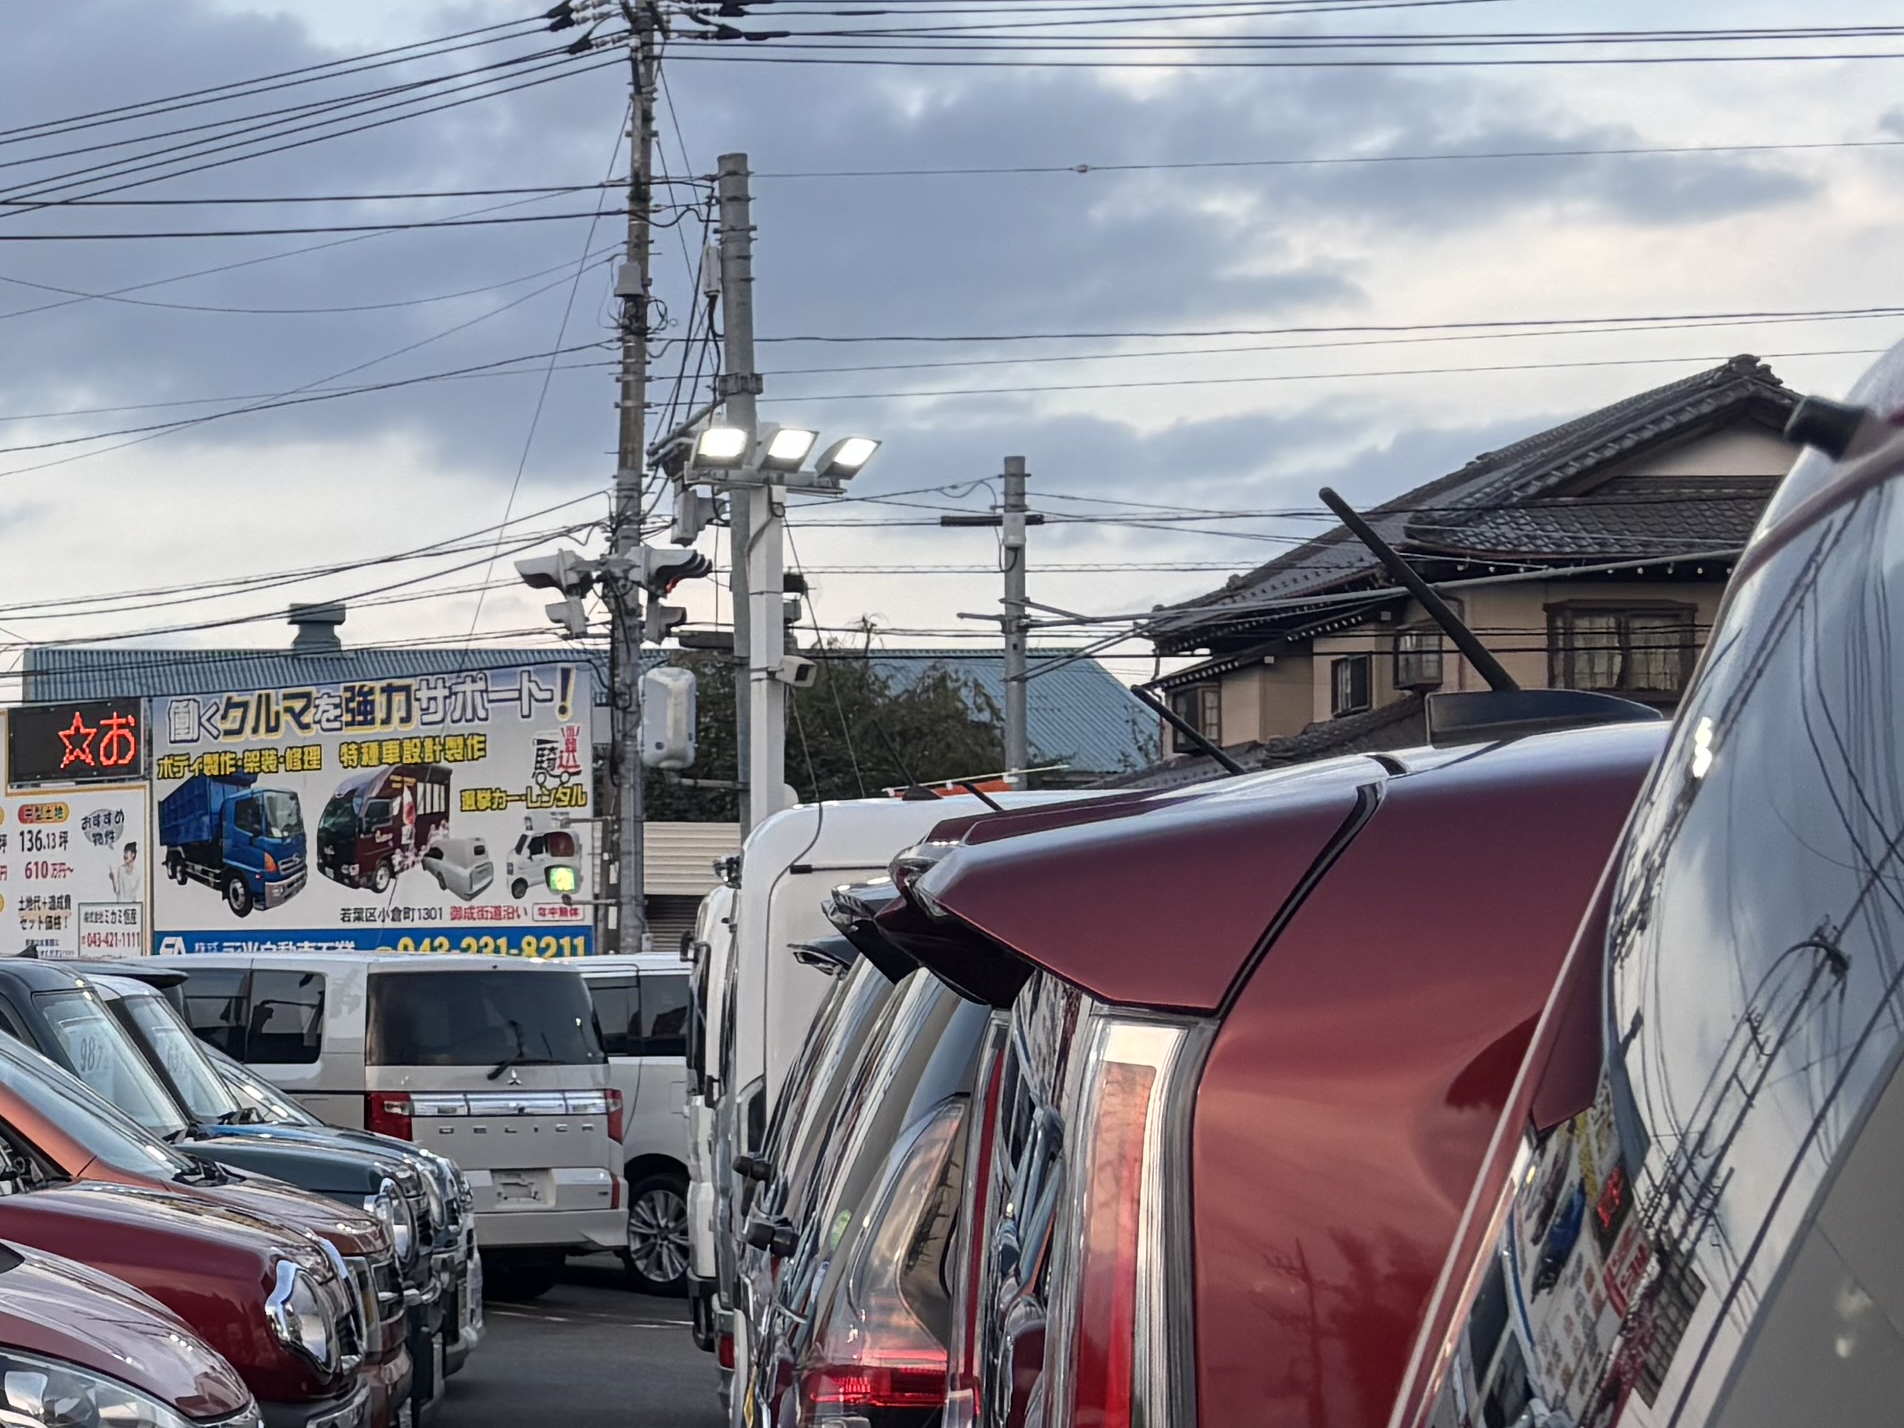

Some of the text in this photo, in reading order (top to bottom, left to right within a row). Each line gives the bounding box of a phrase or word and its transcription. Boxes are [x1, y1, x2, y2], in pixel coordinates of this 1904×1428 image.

[19, 829, 69, 853] 136.13坪
[339, 906, 443, 923] 若葉区小倉町1301
